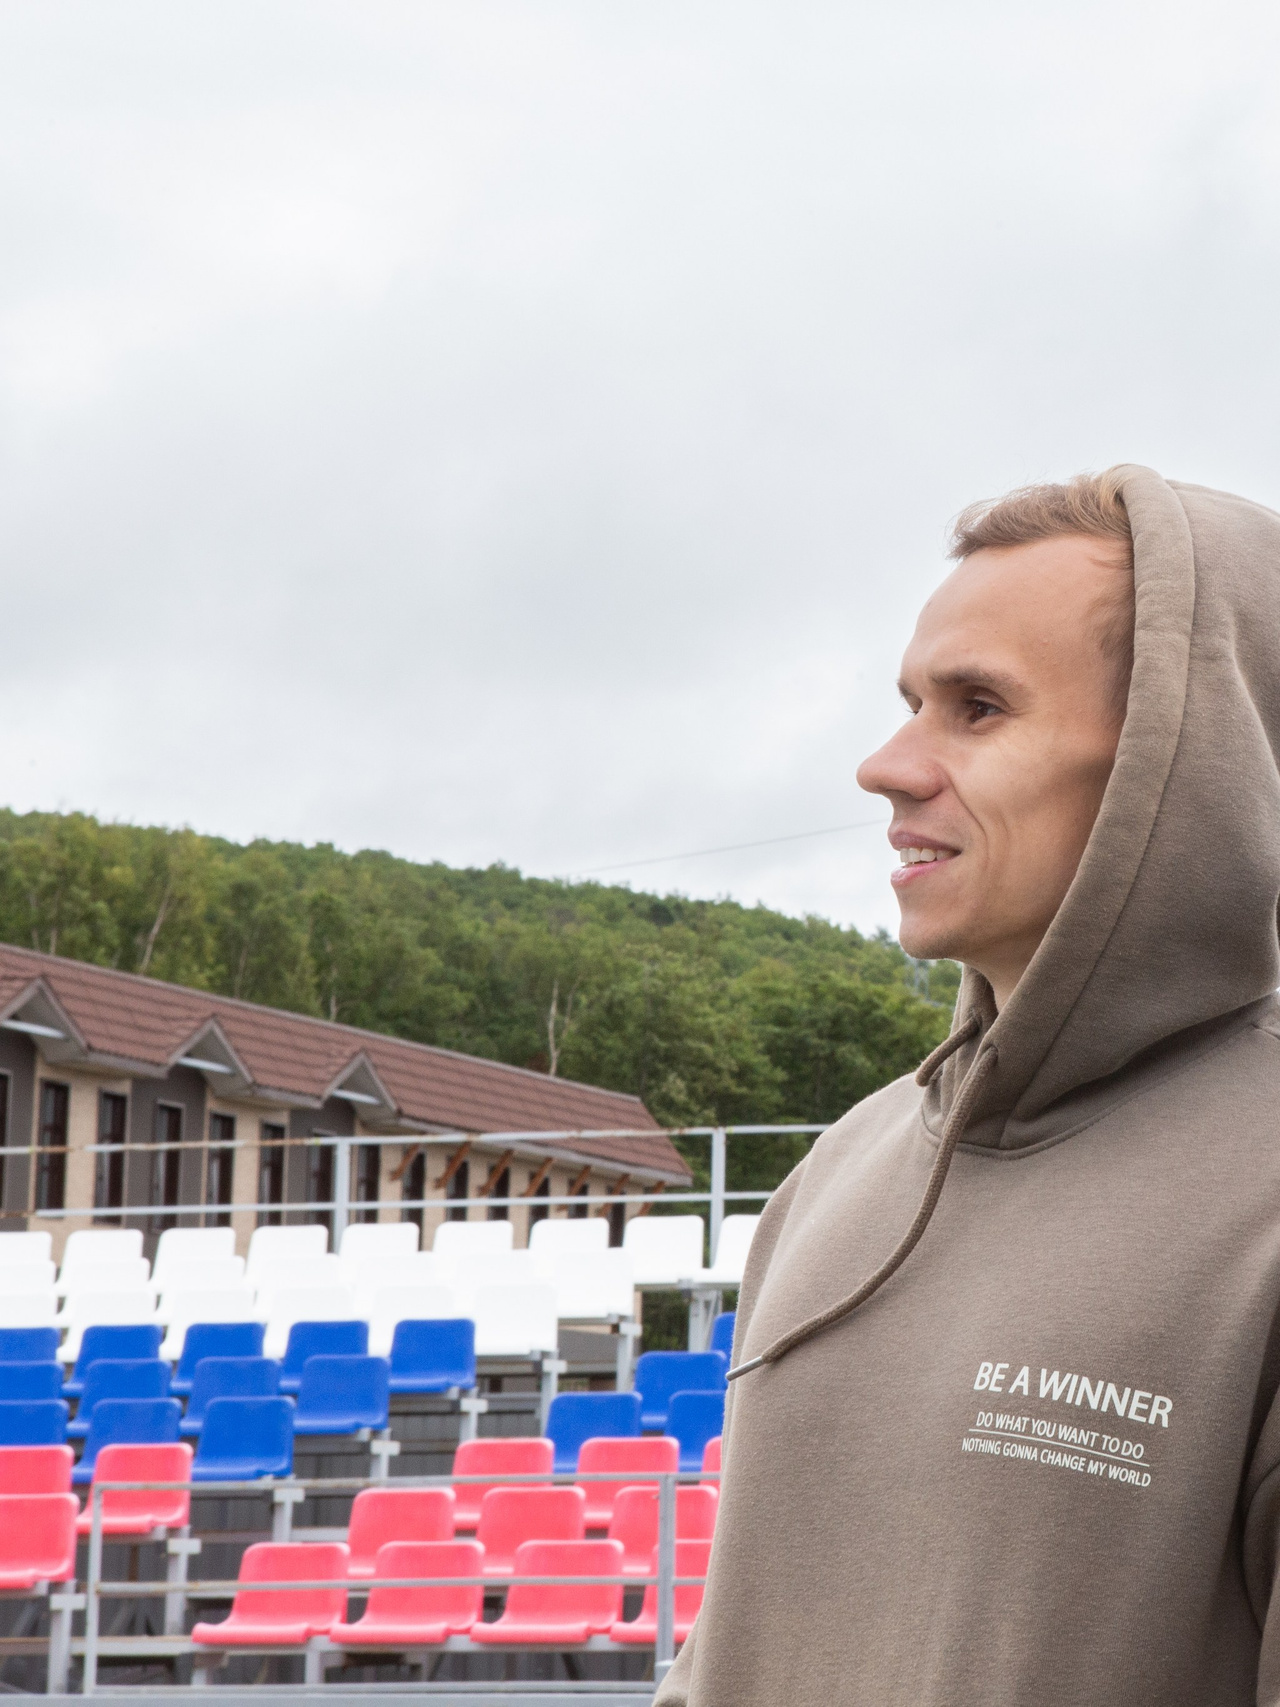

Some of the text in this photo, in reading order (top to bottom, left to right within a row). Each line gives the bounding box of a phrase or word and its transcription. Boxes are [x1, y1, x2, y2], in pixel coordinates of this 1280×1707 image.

[973, 1361, 1173, 1428] BE A WINNER
[975, 1411, 1145, 1460] DO WHAT YOU WANT TO DO
[961, 1437, 1152, 1488] NOTHING GONNA CHANGE MY WORLD
